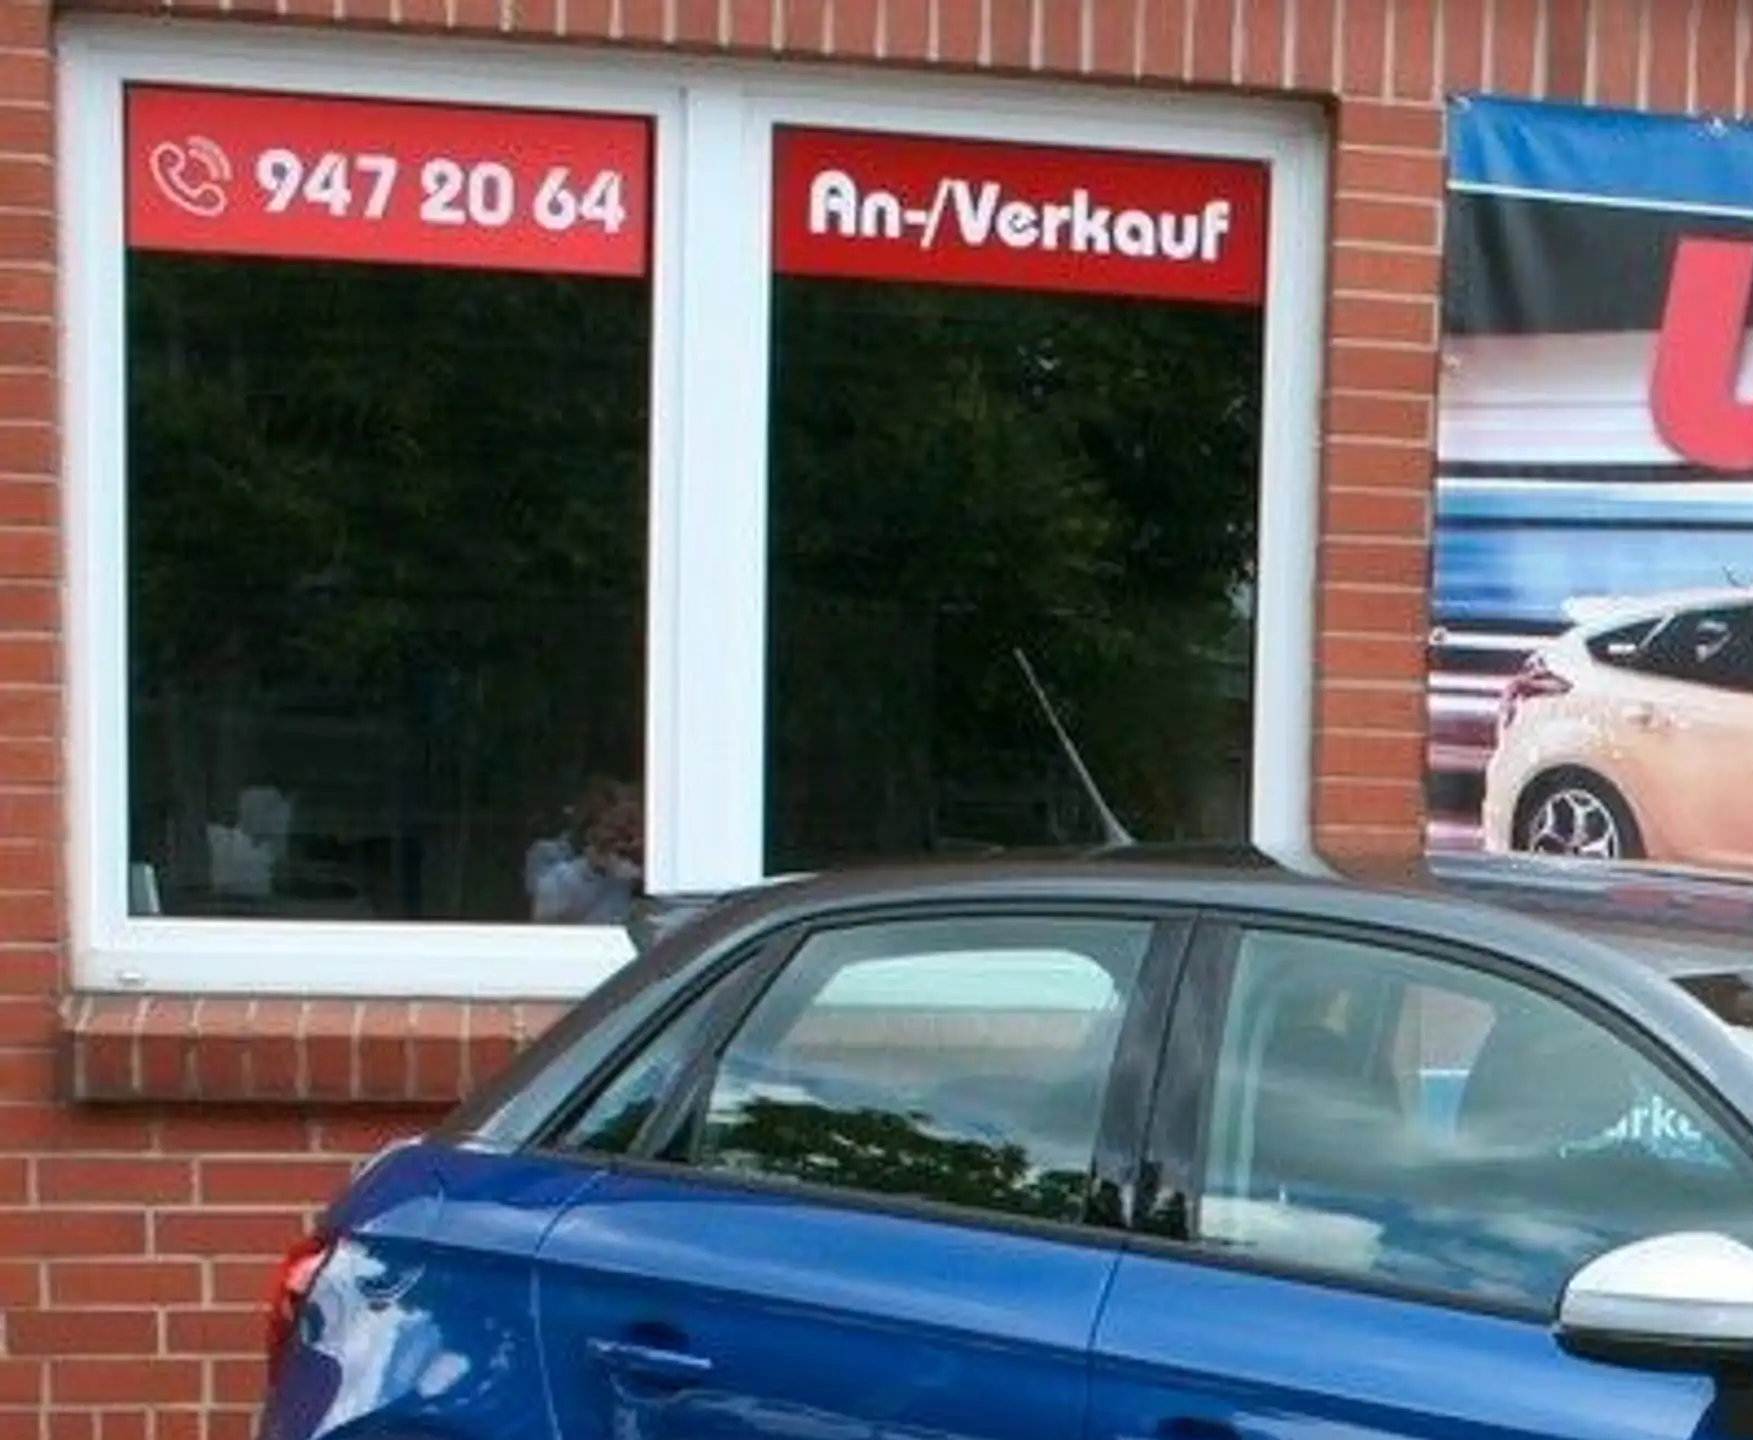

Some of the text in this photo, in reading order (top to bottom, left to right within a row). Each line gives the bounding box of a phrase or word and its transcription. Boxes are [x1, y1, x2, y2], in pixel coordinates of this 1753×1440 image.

[256, 149, 626, 233] 947 20 64
[810, 168, 1230, 261] An-/Verkauf
